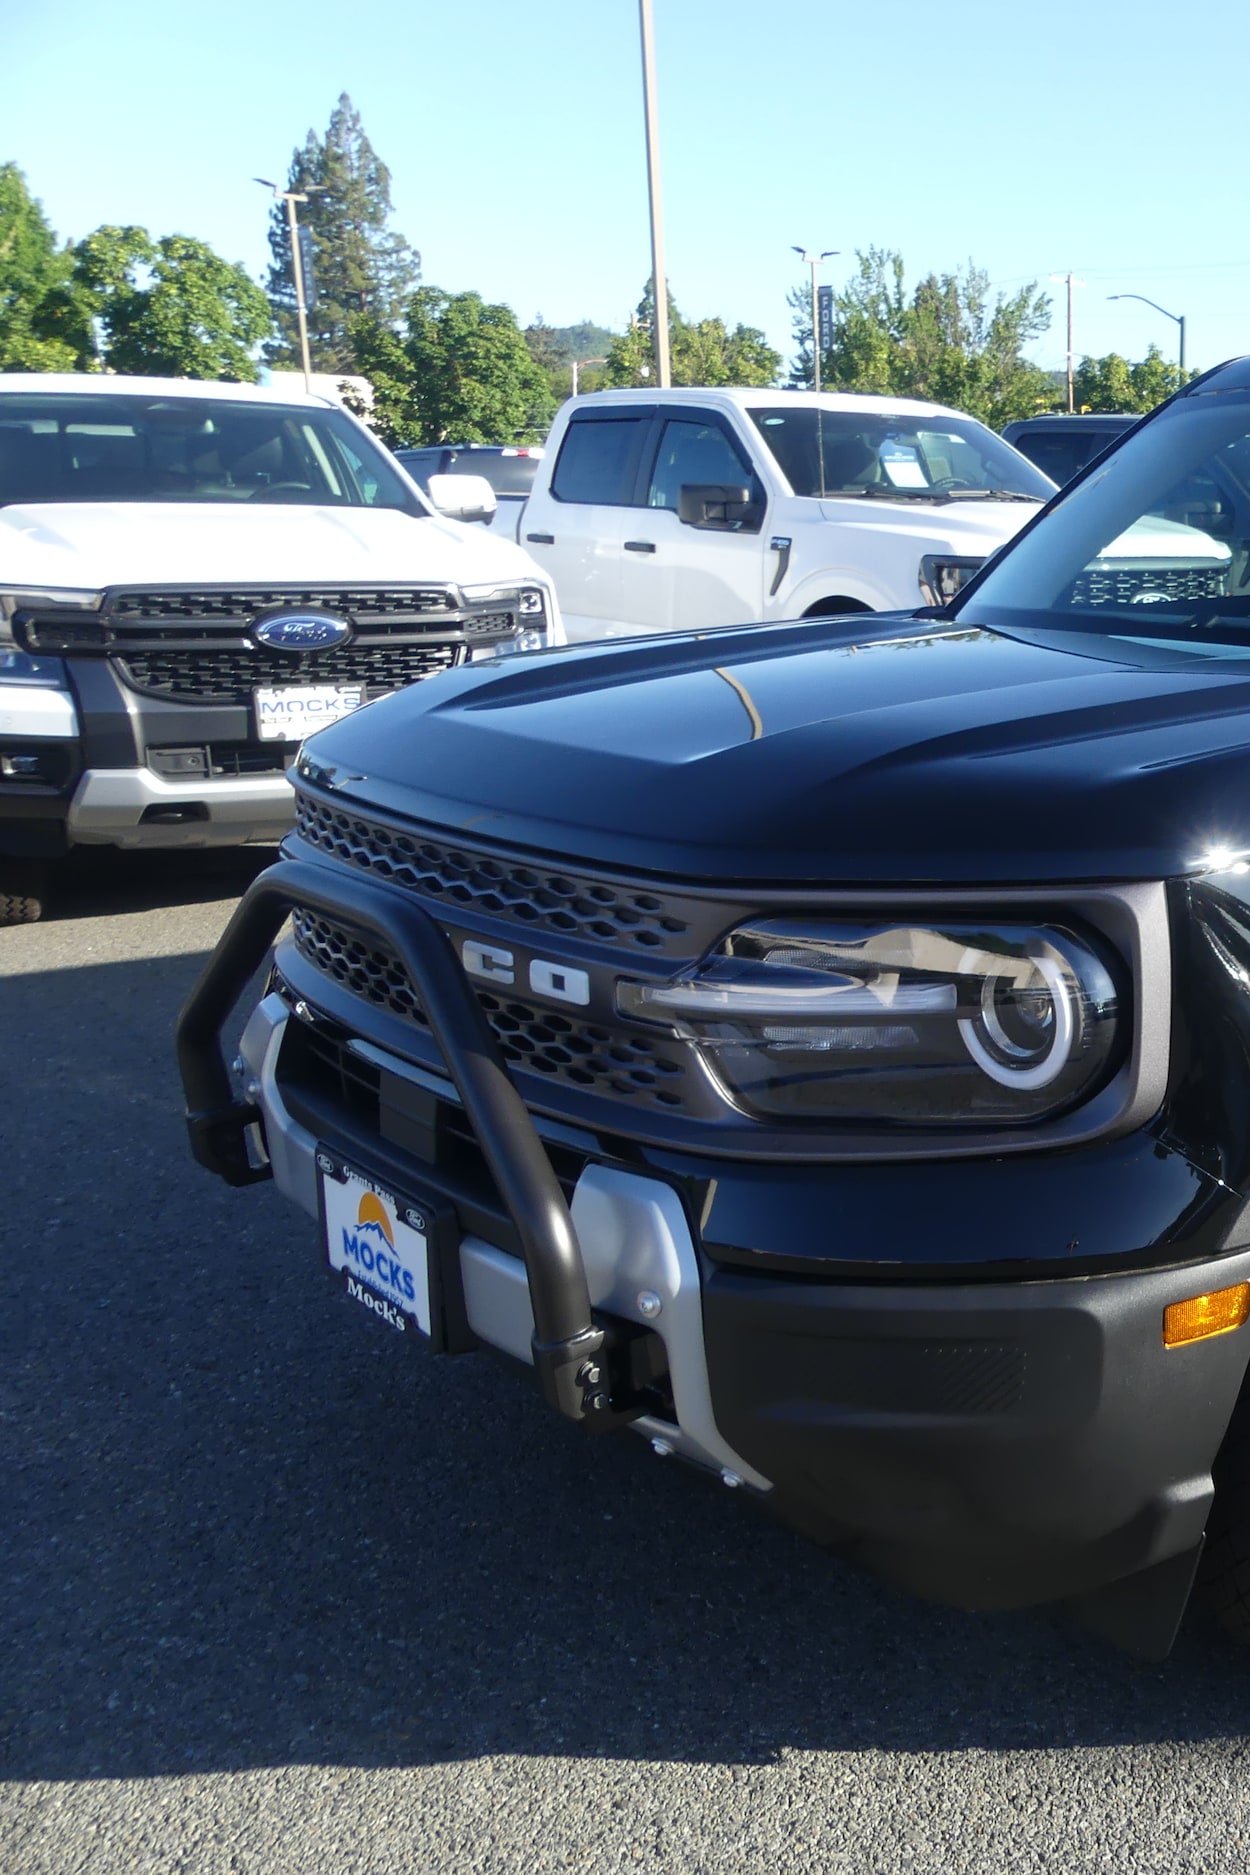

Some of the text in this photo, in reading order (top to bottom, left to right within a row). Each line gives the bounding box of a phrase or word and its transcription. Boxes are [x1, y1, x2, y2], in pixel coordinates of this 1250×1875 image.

[822, 296, 830, 348] FORD
[283, 622, 328, 643] Ford
[261, 697, 361, 714] MOCKS
[462, 939, 590, 1006] CO
[343, 1165, 373, 1192] Grants
[342, 1227, 415, 1300] MOCKS
[347, 1276, 405, 1331] Mock's
